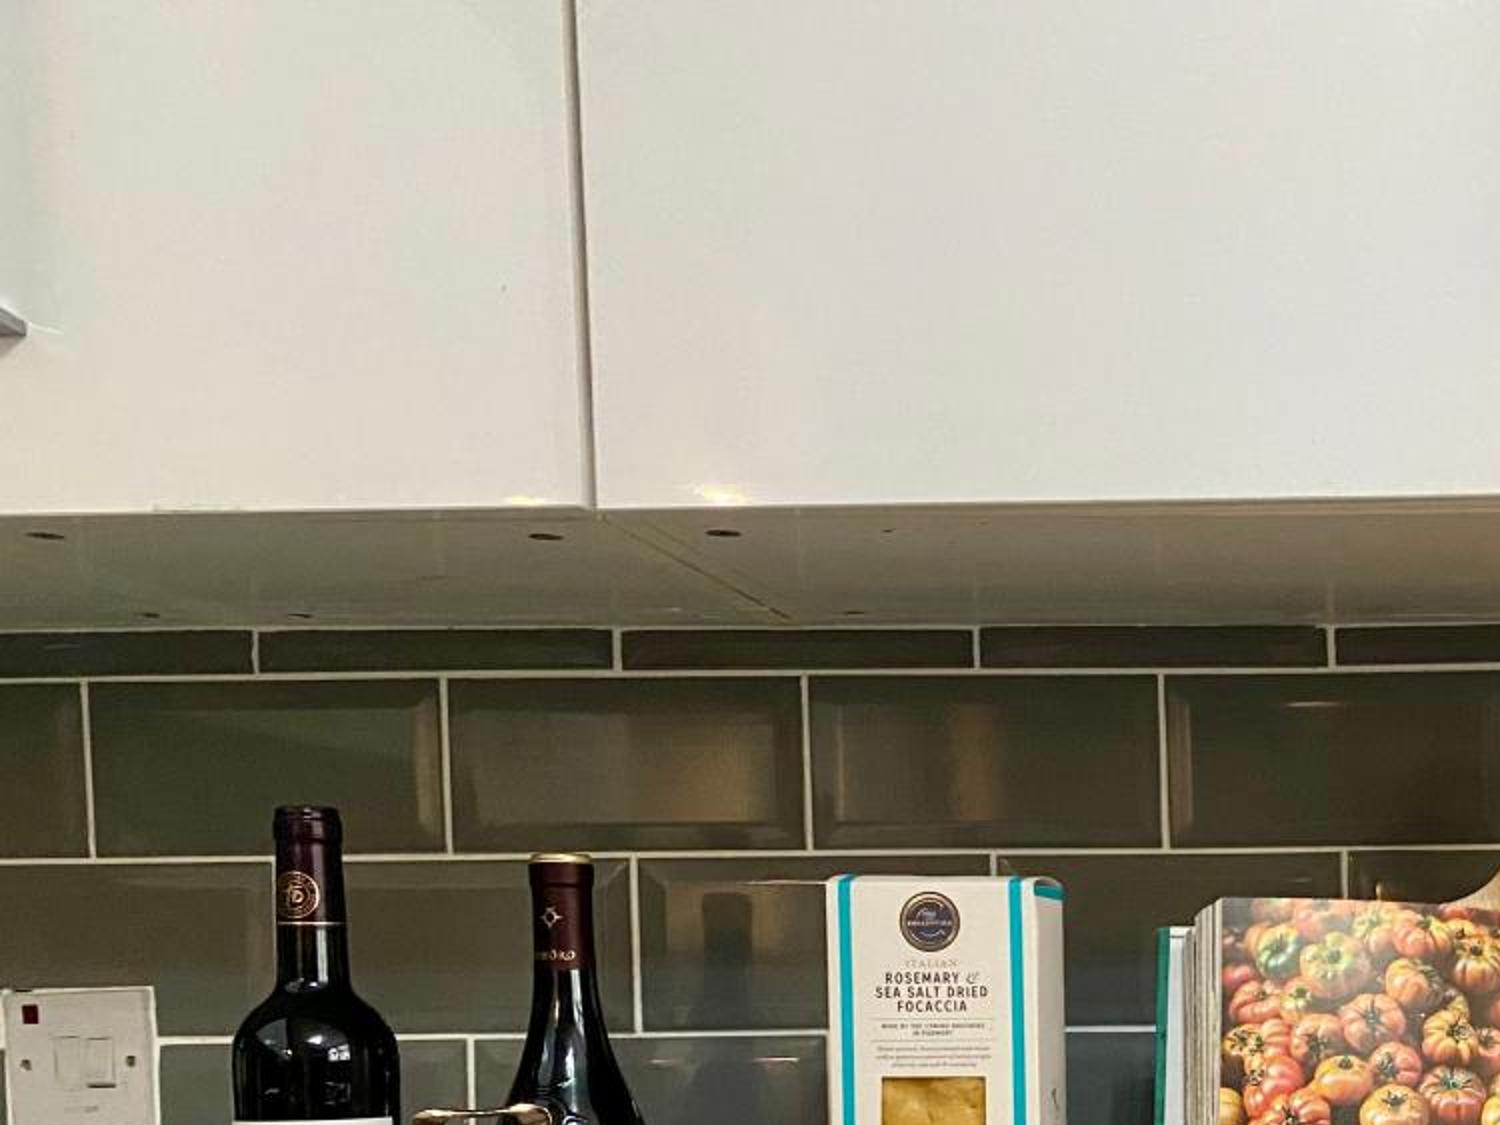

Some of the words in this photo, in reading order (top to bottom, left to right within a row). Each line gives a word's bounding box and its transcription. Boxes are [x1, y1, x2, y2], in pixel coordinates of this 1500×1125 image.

[884, 971, 960, 984] ROSEMARY
[965, 971, 981, 985] &
[874, 986, 901, 999] SEA
[907, 986, 940, 999] SALT
[947, 985, 989, 998] DRIED
[896, 999, 968, 1013] FOCACCIA
